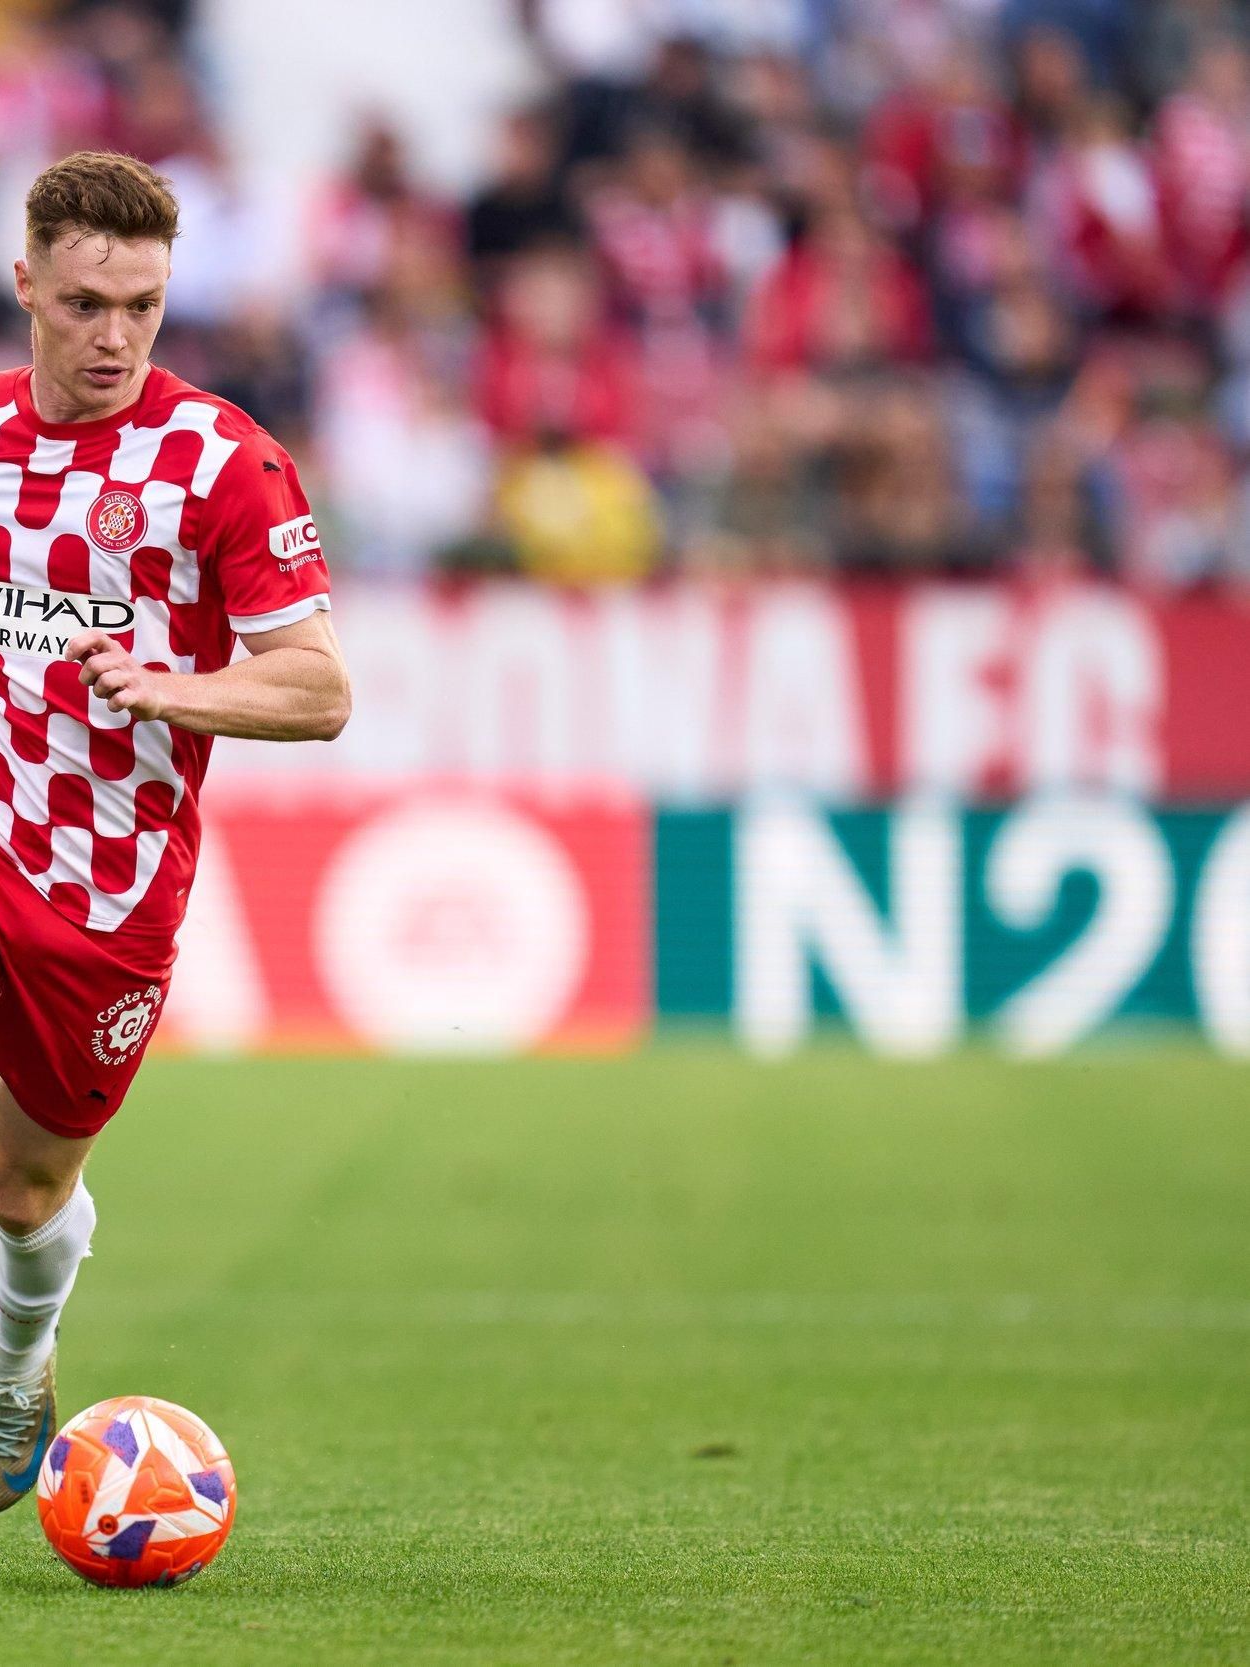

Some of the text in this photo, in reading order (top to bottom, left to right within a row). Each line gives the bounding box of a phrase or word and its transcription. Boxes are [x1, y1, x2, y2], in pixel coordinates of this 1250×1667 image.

[104, 494, 139, 513] GIRONA
[115, 539, 131, 547] CLUB
[895, 578, 1162, 795] FC
[96, 991, 141, 1024] Costa
[91, 1029, 112, 1065] Pirineu
[113, 1054, 127, 1066] de
